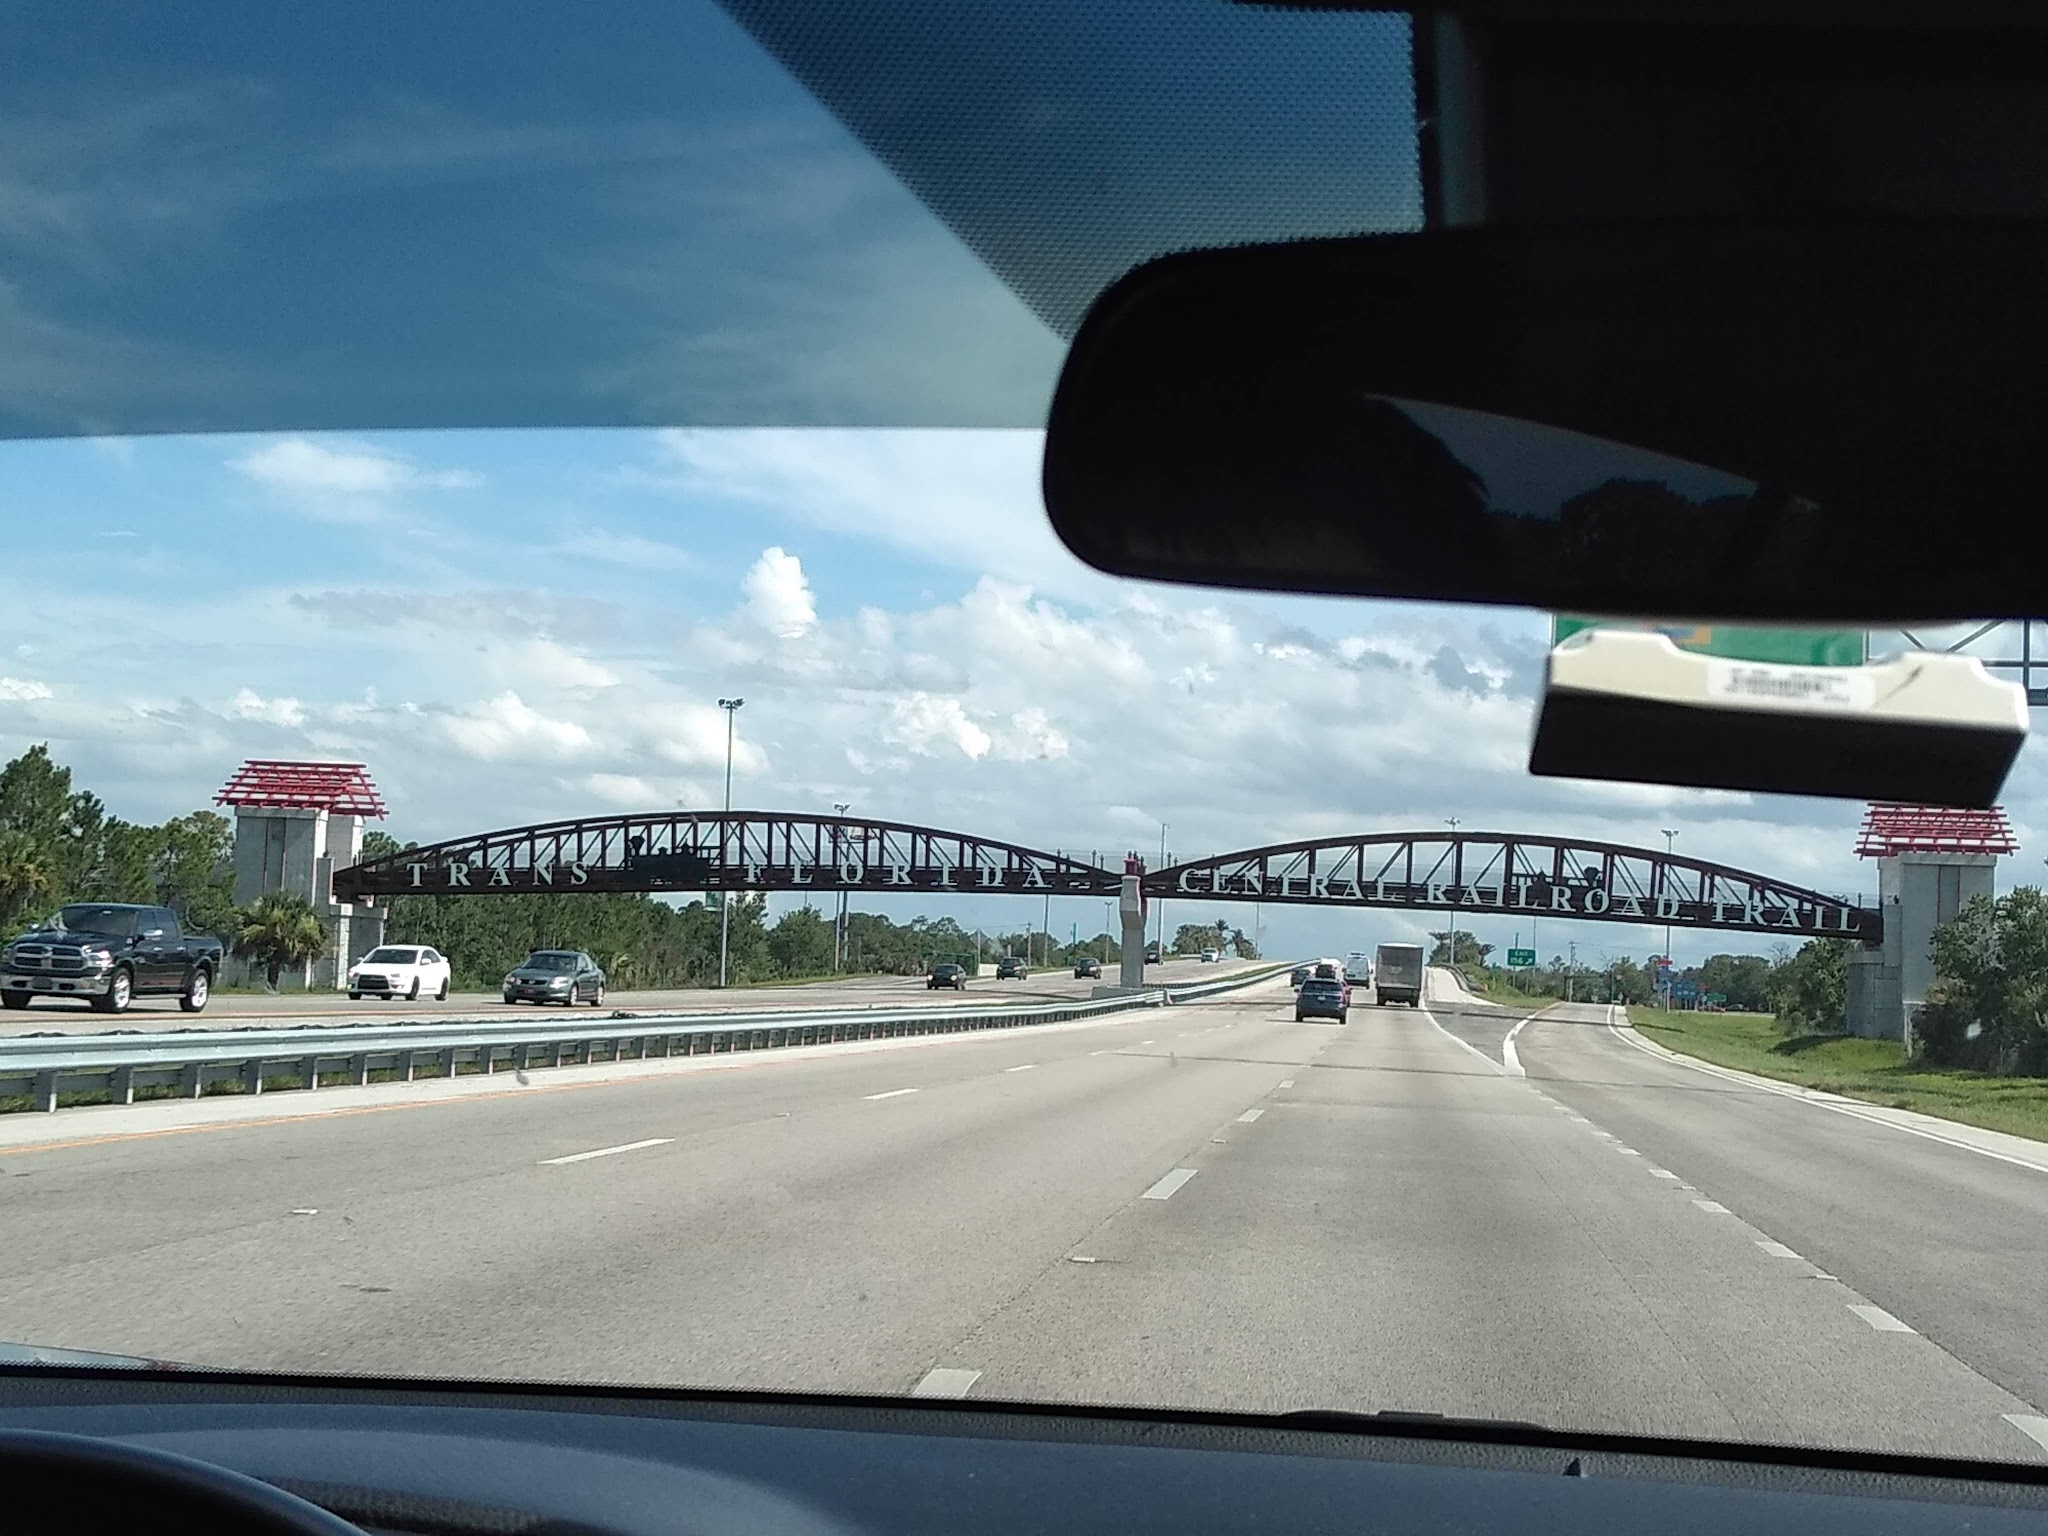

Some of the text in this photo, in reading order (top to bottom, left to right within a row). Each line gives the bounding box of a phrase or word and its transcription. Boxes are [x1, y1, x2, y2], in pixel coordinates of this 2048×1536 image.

[406, 860, 1862, 933] TRANS FLORIDA CENTRAL RAILROAD TRAIL
